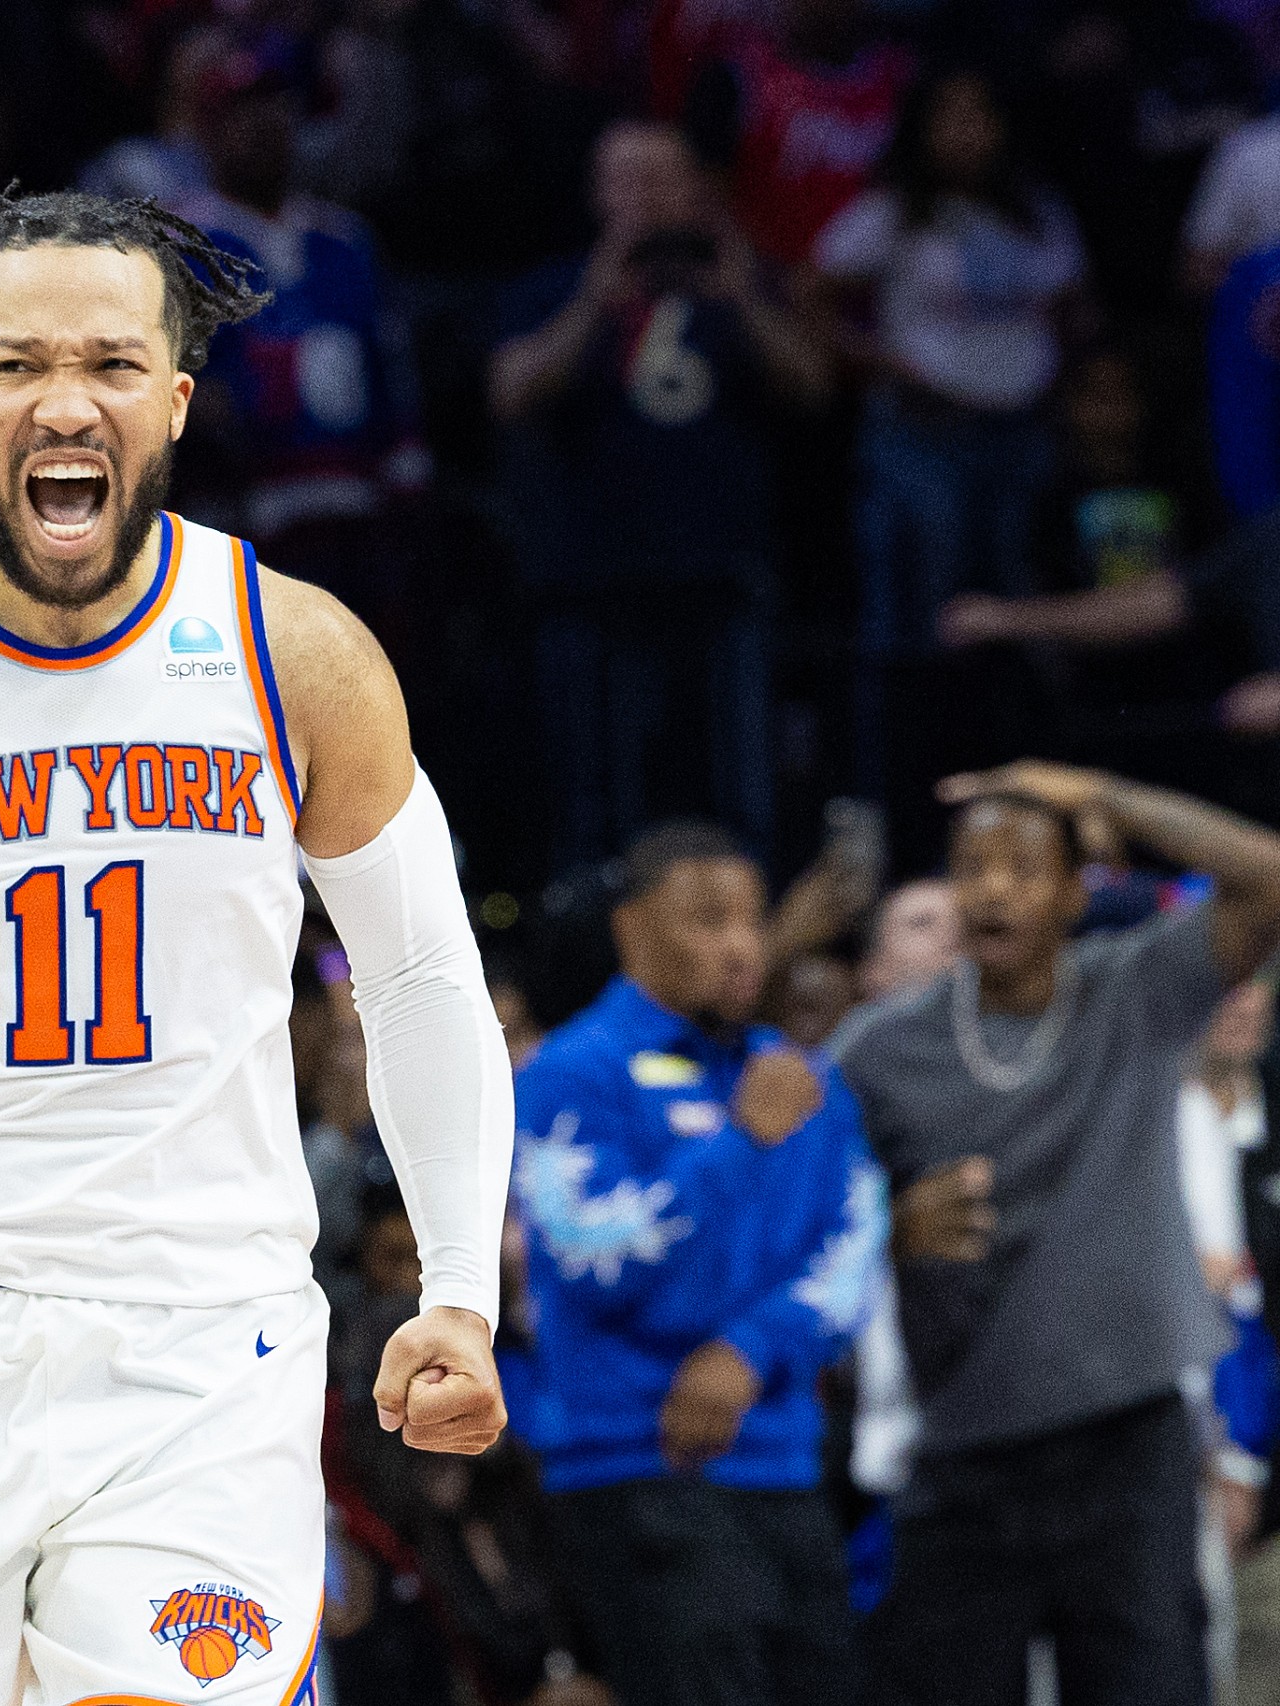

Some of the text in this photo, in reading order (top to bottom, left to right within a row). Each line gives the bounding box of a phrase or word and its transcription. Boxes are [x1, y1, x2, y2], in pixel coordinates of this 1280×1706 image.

[165, 659, 237, 680] sphere
[66, 741, 265, 840] YORK
[5, 859, 153, 1067] 11
[149, 1588, 272, 1653] KNICKS
[193, 1582, 244, 1600] NEW YORK
